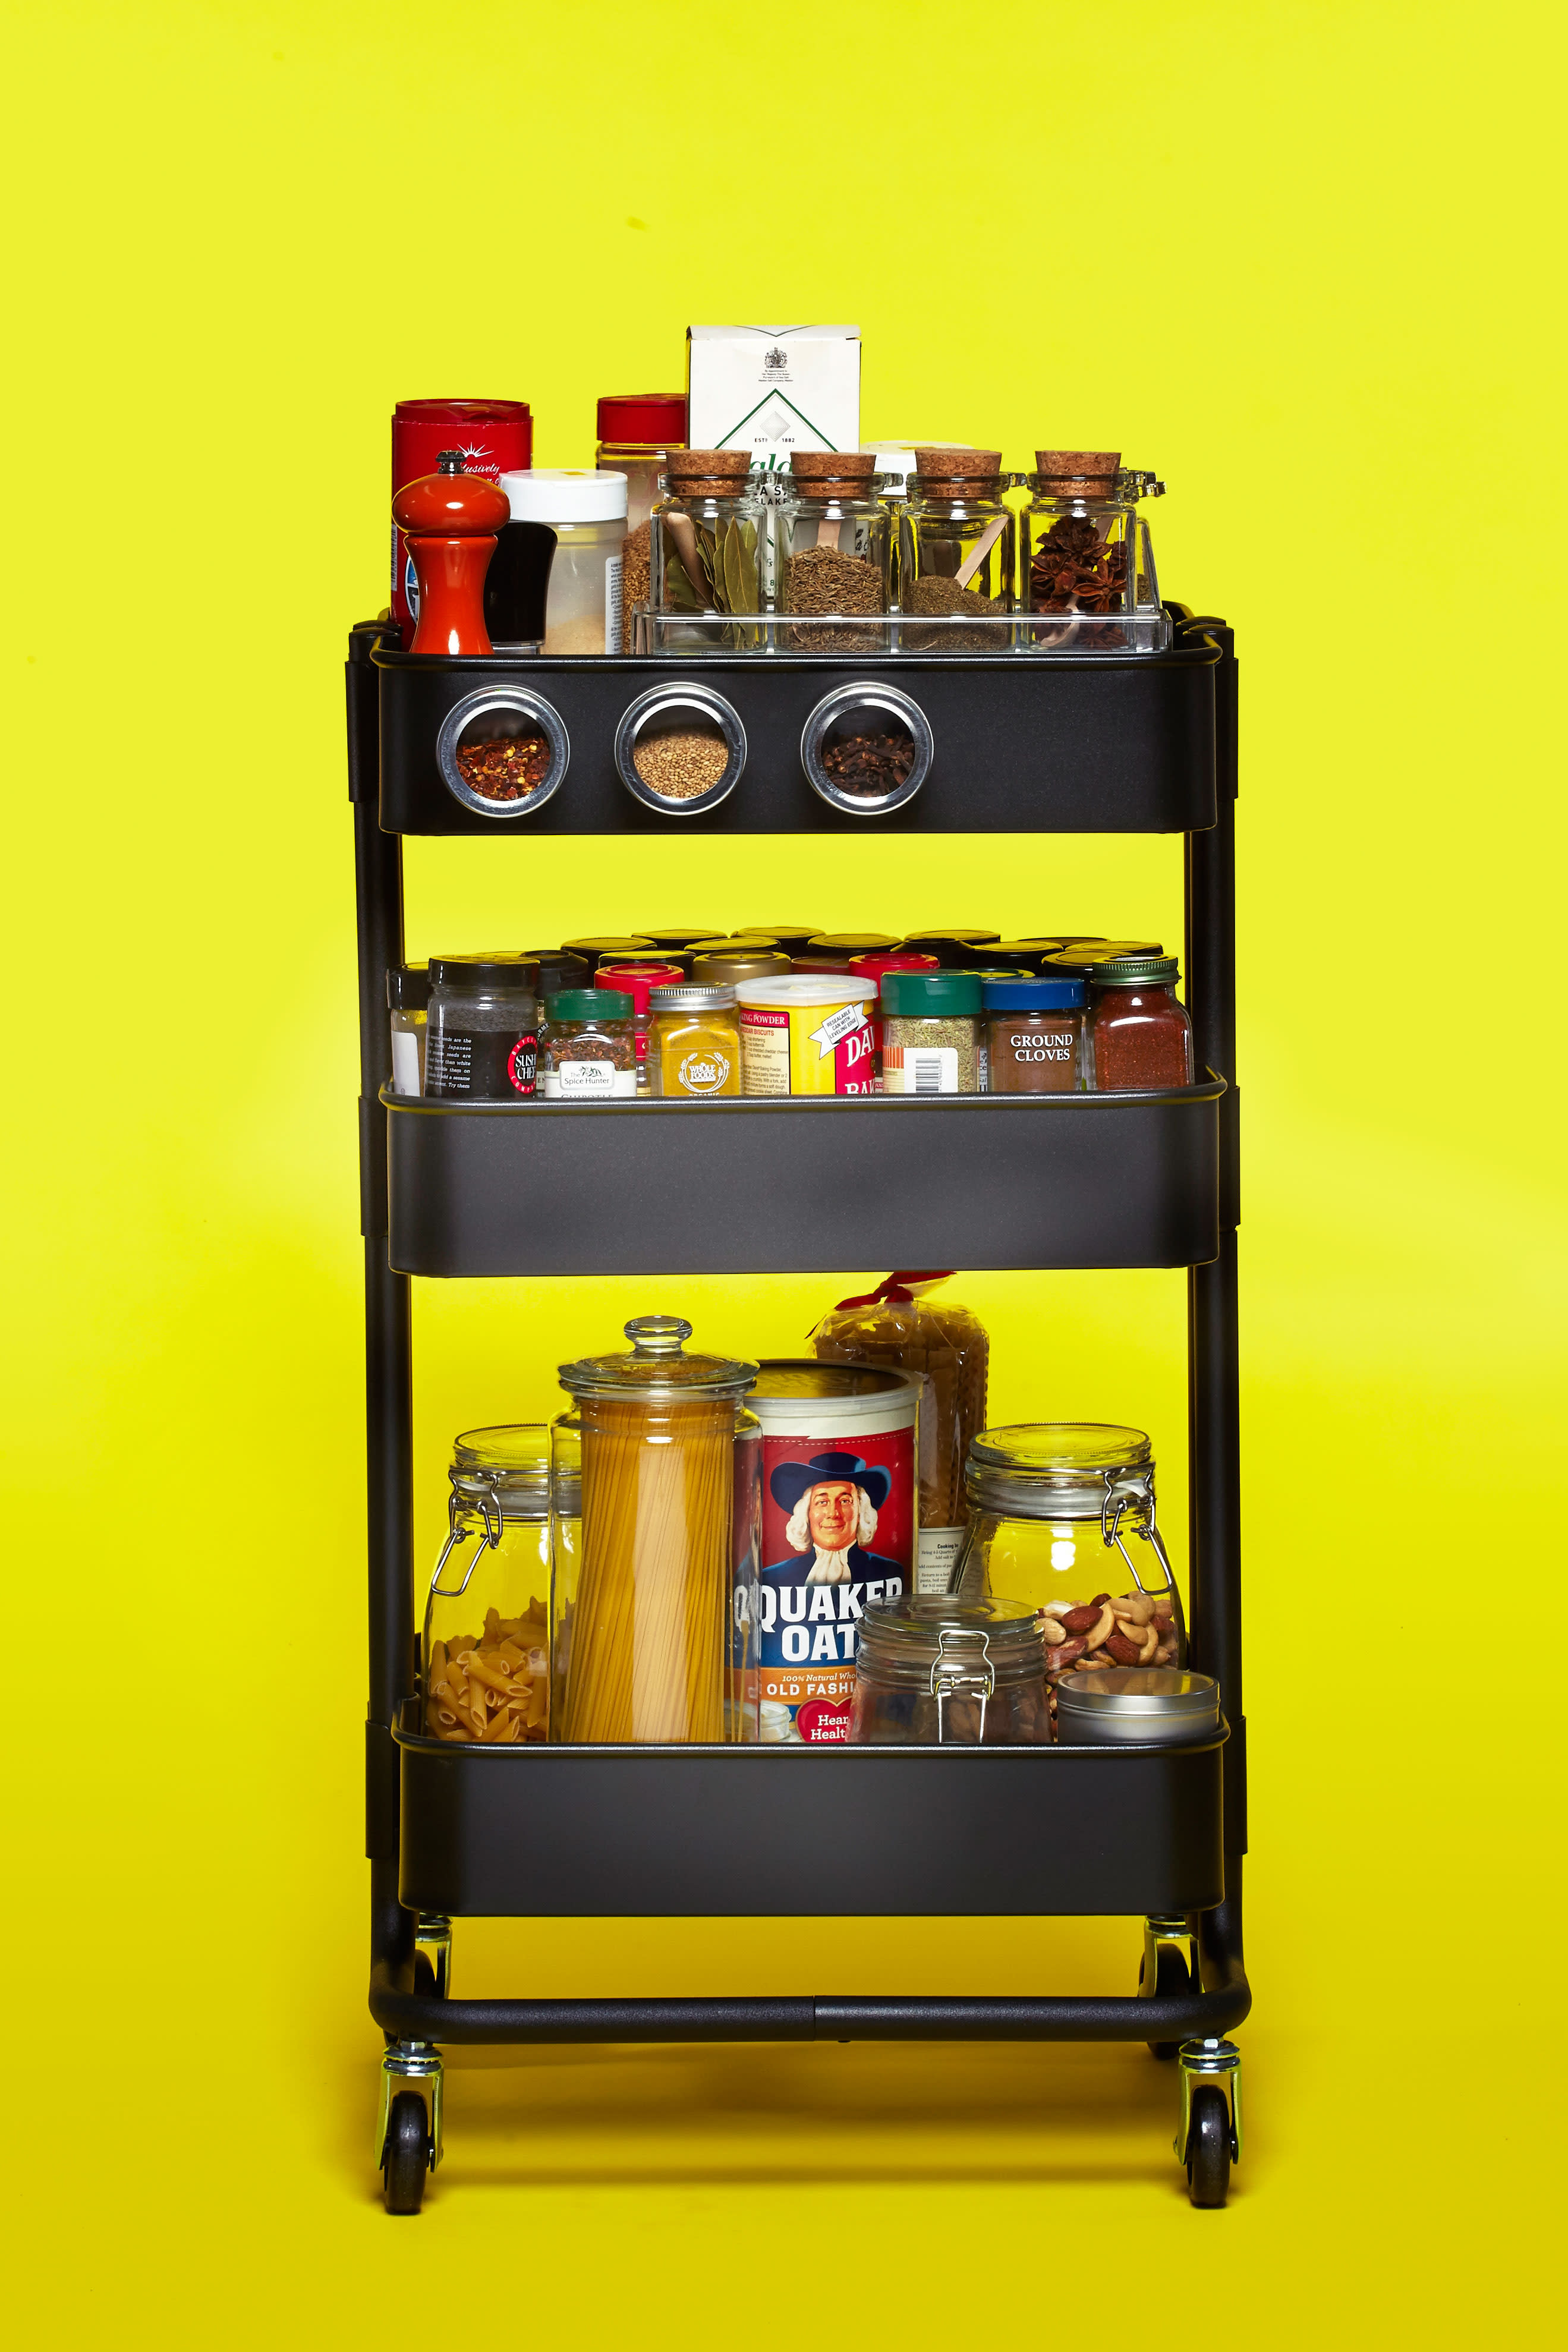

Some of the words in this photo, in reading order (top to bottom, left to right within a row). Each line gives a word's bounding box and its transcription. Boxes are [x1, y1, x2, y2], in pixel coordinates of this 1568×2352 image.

[463, 464, 500, 475] lusively
[741, 1012, 752, 1022] KING
[753, 1013, 785, 1025] POWDER
[827, 1009, 851, 1028] RESEALABLE
[832, 1022, 841, 1031] CAN
[840, 1016, 851, 1026] WITH
[830, 1025, 848, 1039] LEVELING
[847, 1017, 857, 1027] EDGE
[1010, 1034, 1073, 1047] GROUND
[515, 1054, 537, 1068] SUSH
[1015, 1049, 1070, 1062] CLOVES
[689, 1063, 716, 1073] WHOLE
[782, 1623, 857, 1662] OAT
[805, 1673, 837, 1682] Natural
[839, 1671, 858, 1680] Whol
[767, 1683, 799, 1695] OLD
[807, 1682, 855, 1695] FASHI
[818, 1714, 849, 1726] Hear
[810, 1727, 846, 1740] Healt
